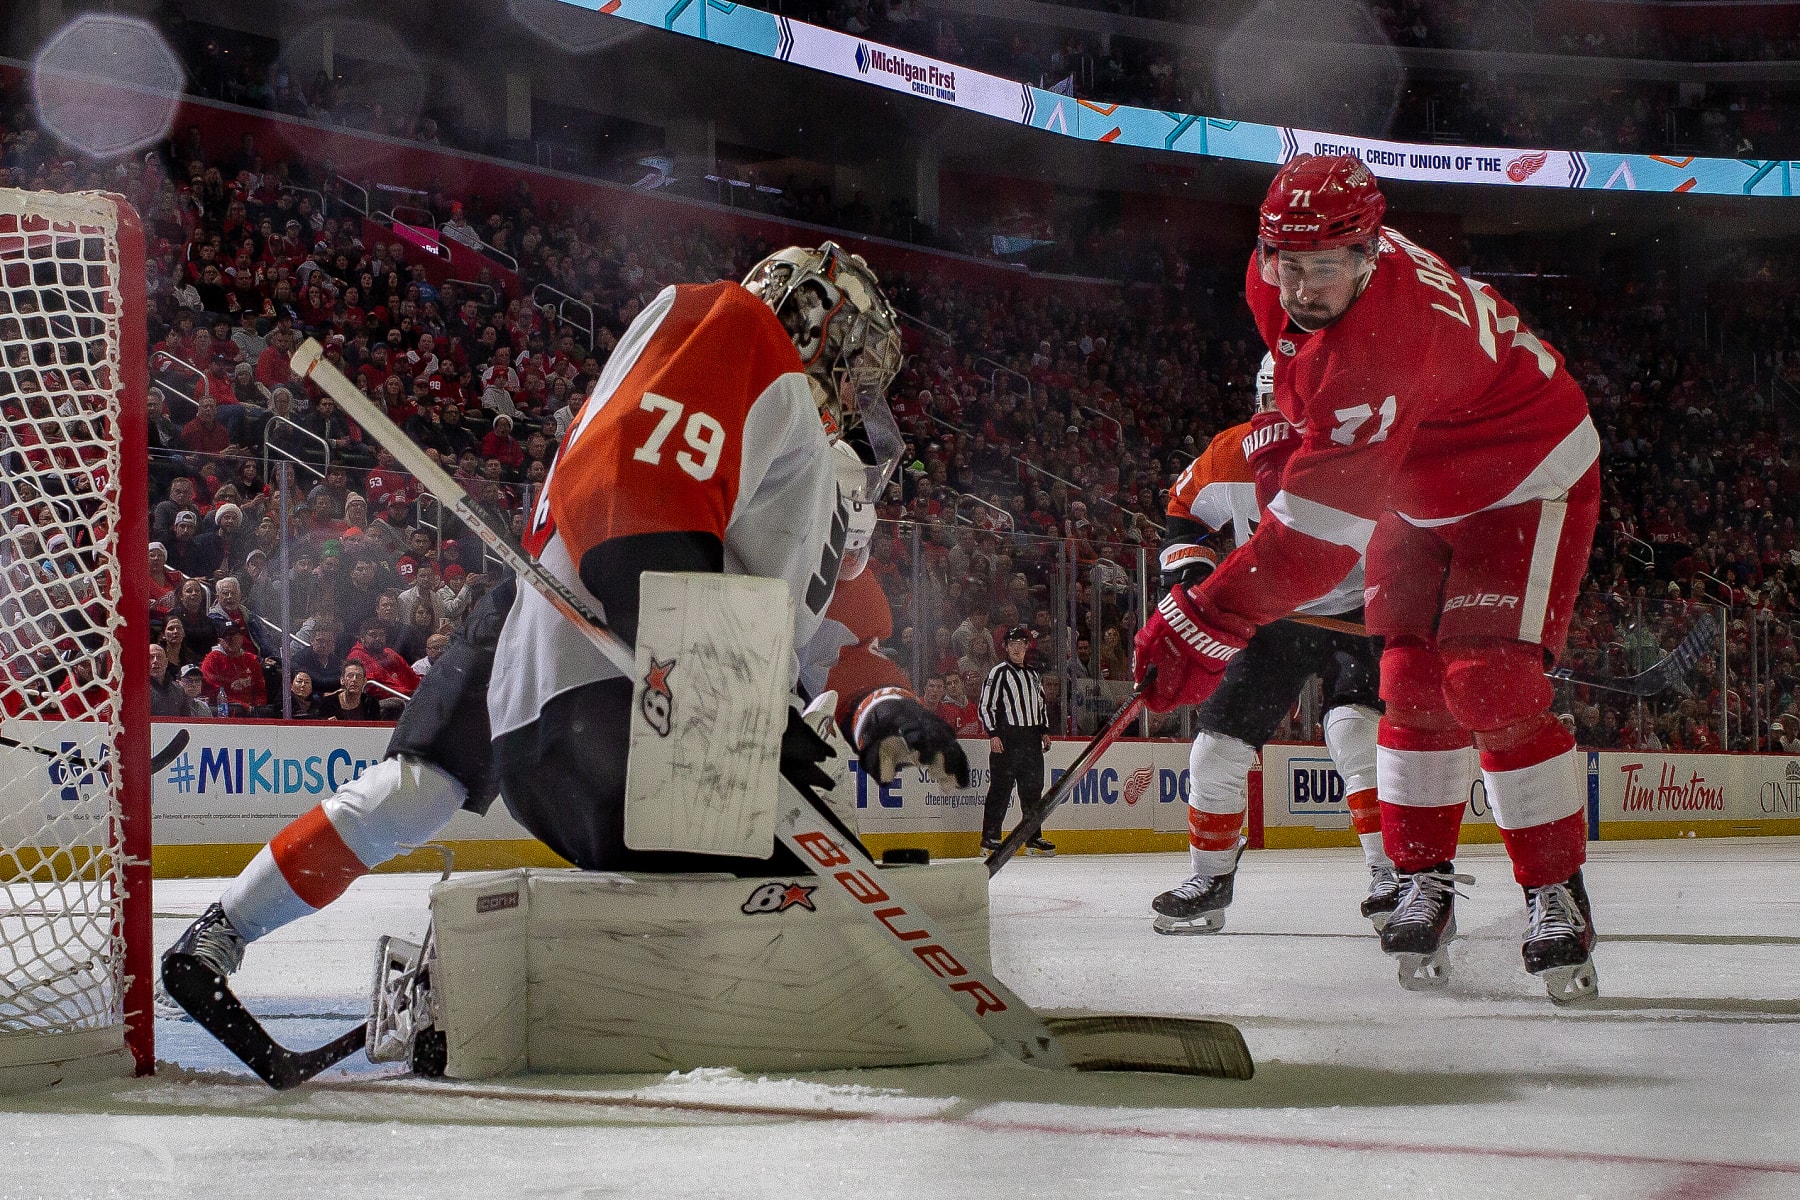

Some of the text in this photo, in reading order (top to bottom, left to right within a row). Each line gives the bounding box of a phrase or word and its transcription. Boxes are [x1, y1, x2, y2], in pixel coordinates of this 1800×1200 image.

[871, 49, 956, 90] Michigan First
[911, 81, 956, 103] CREDIT UNION
[1314, 142, 1501, 172] OFFICIAL CREDIT UNION OF THE
[1289, 189, 1312, 208] 71
[1281, 223, 1320, 232] CCM
[1330, 395, 1398, 446] 71
[633, 391, 727, 481] 79
[369, 476, 383, 488] 53
[400, 563, 413, 576] 93
[848, 759, 903, 809] TE
[1620, 761, 1725, 812] Tim Hortons
[213, 812, 240, 822] corporations
[241, 812, 250, 820] and
[792, 831, 1008, 1018] BAUER
